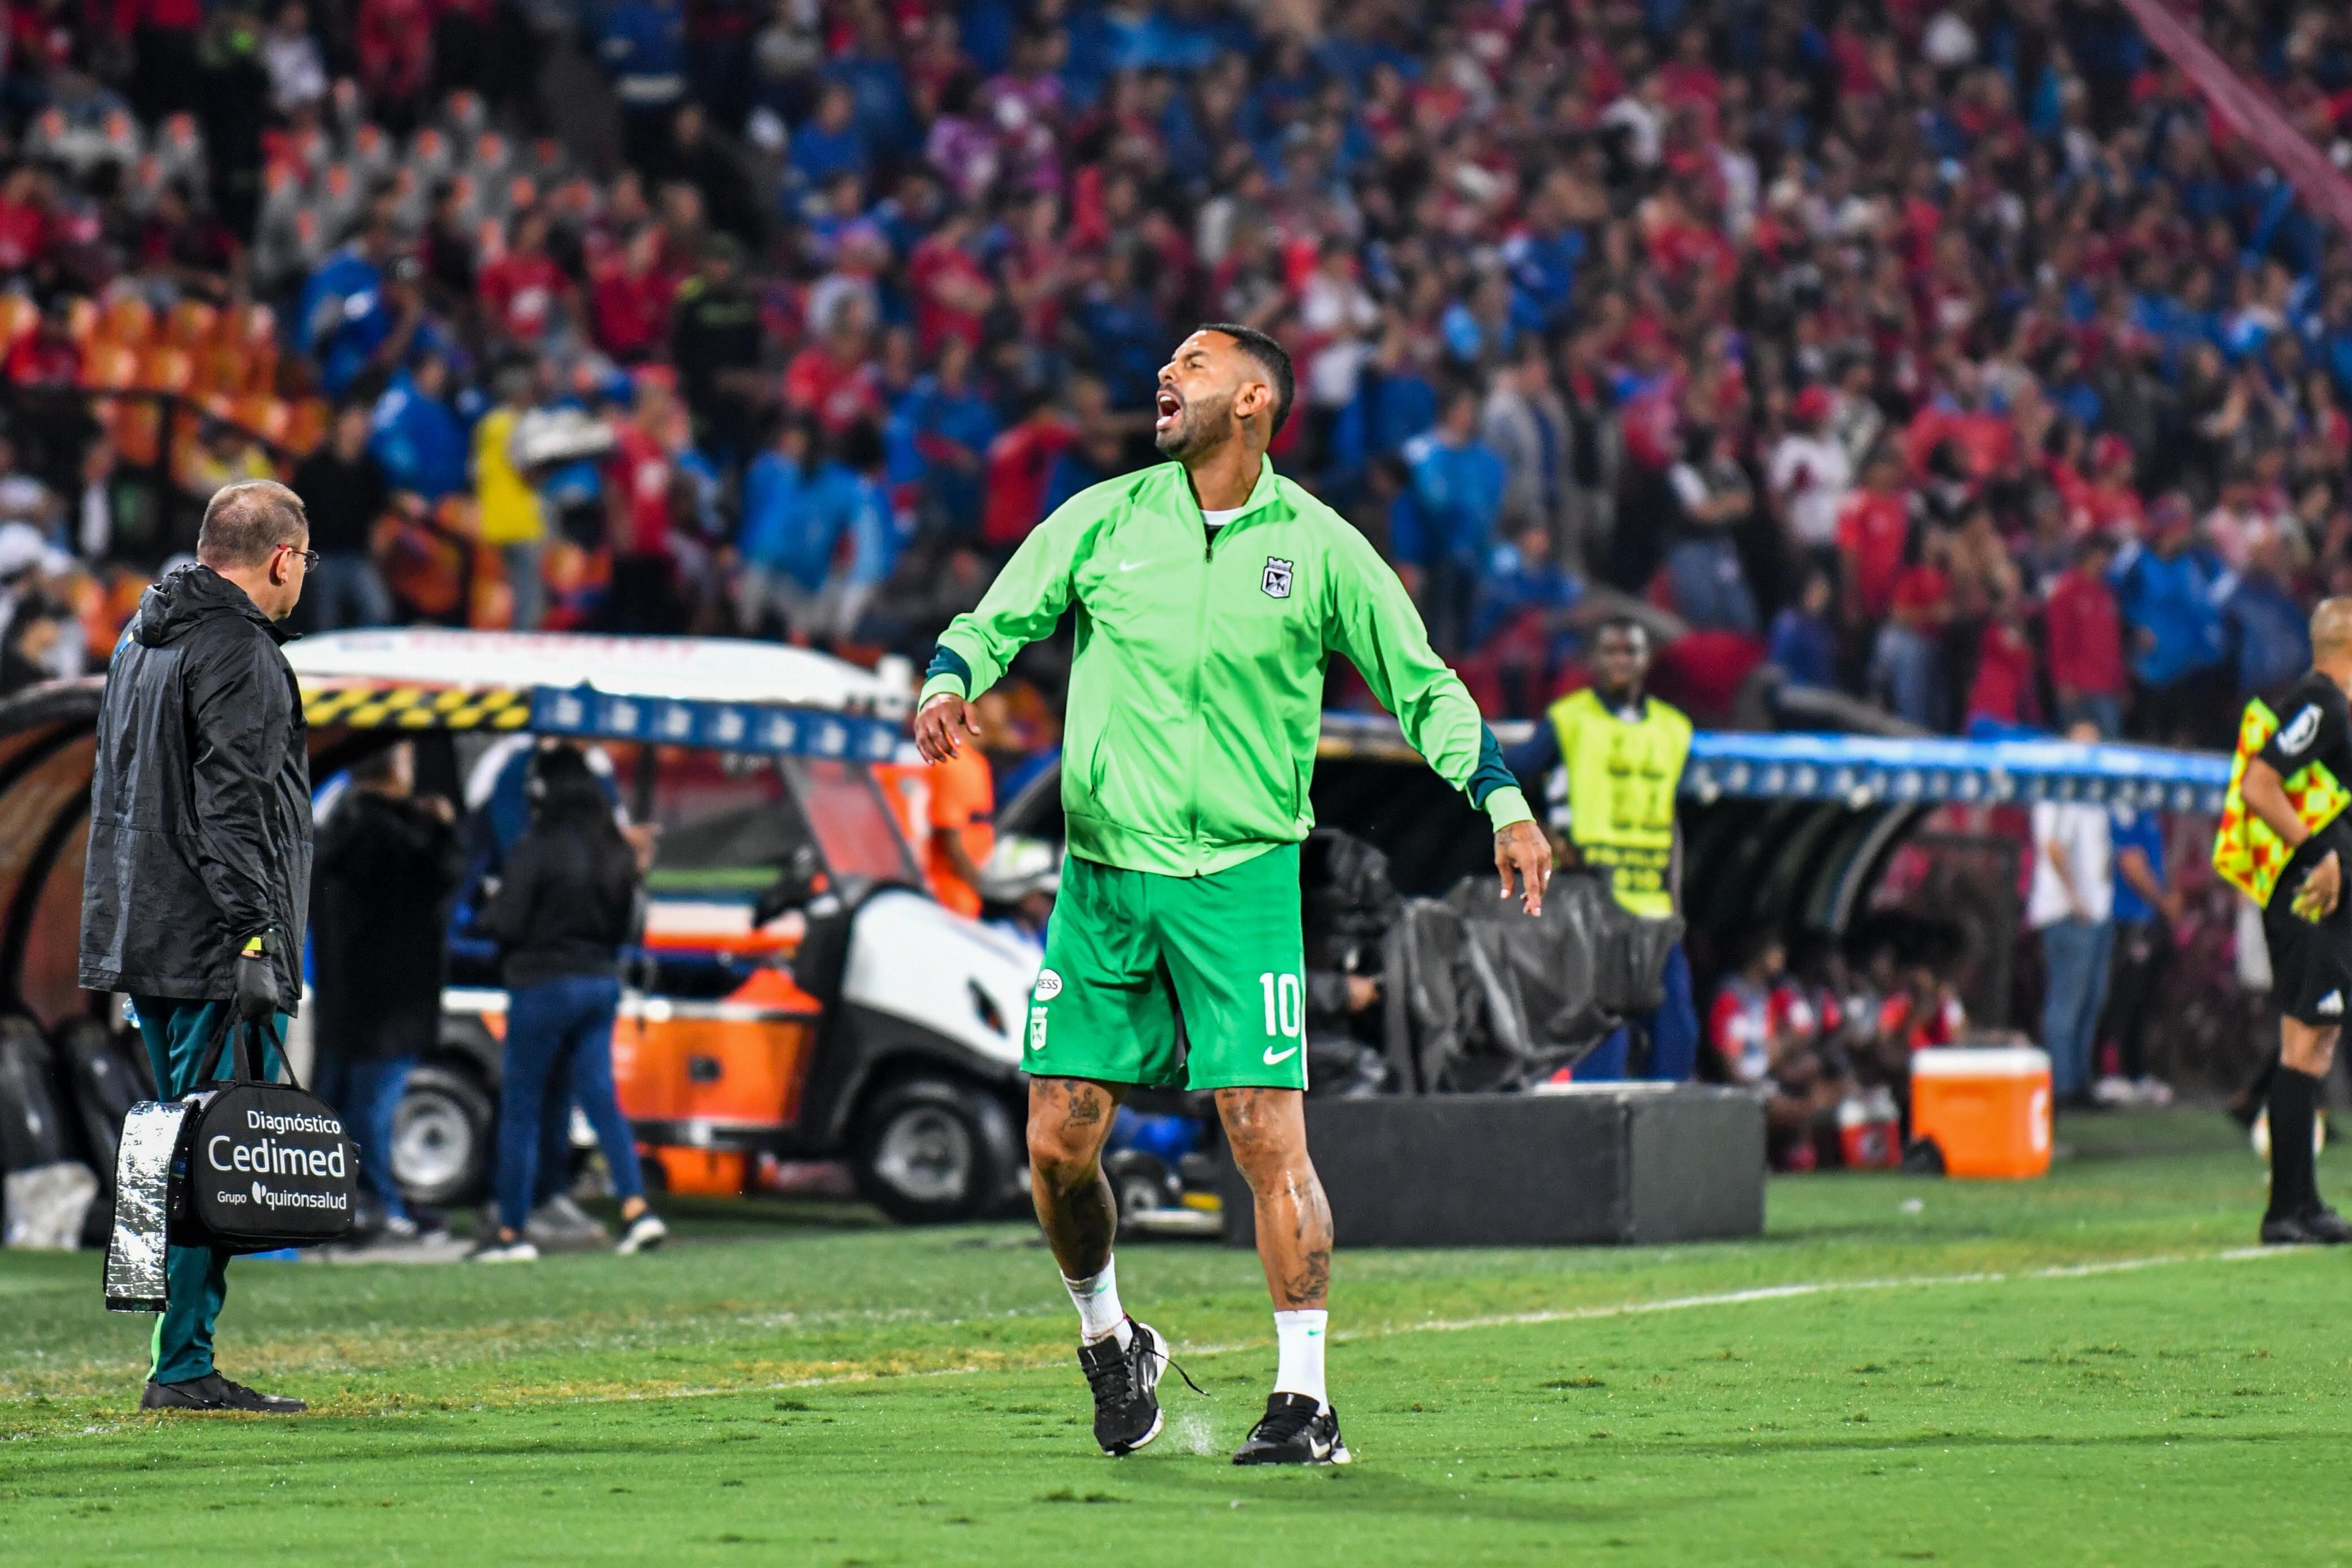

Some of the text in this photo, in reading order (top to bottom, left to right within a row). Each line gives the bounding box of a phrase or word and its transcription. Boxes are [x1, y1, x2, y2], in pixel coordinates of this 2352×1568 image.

[1259, 972, 1300, 1038] 10
[246, 1110, 340, 1134] Diagnóstico
[208, 1135, 346, 1177] Cedimed
[217, 1190, 347, 1211] Grupo quirónsalud
